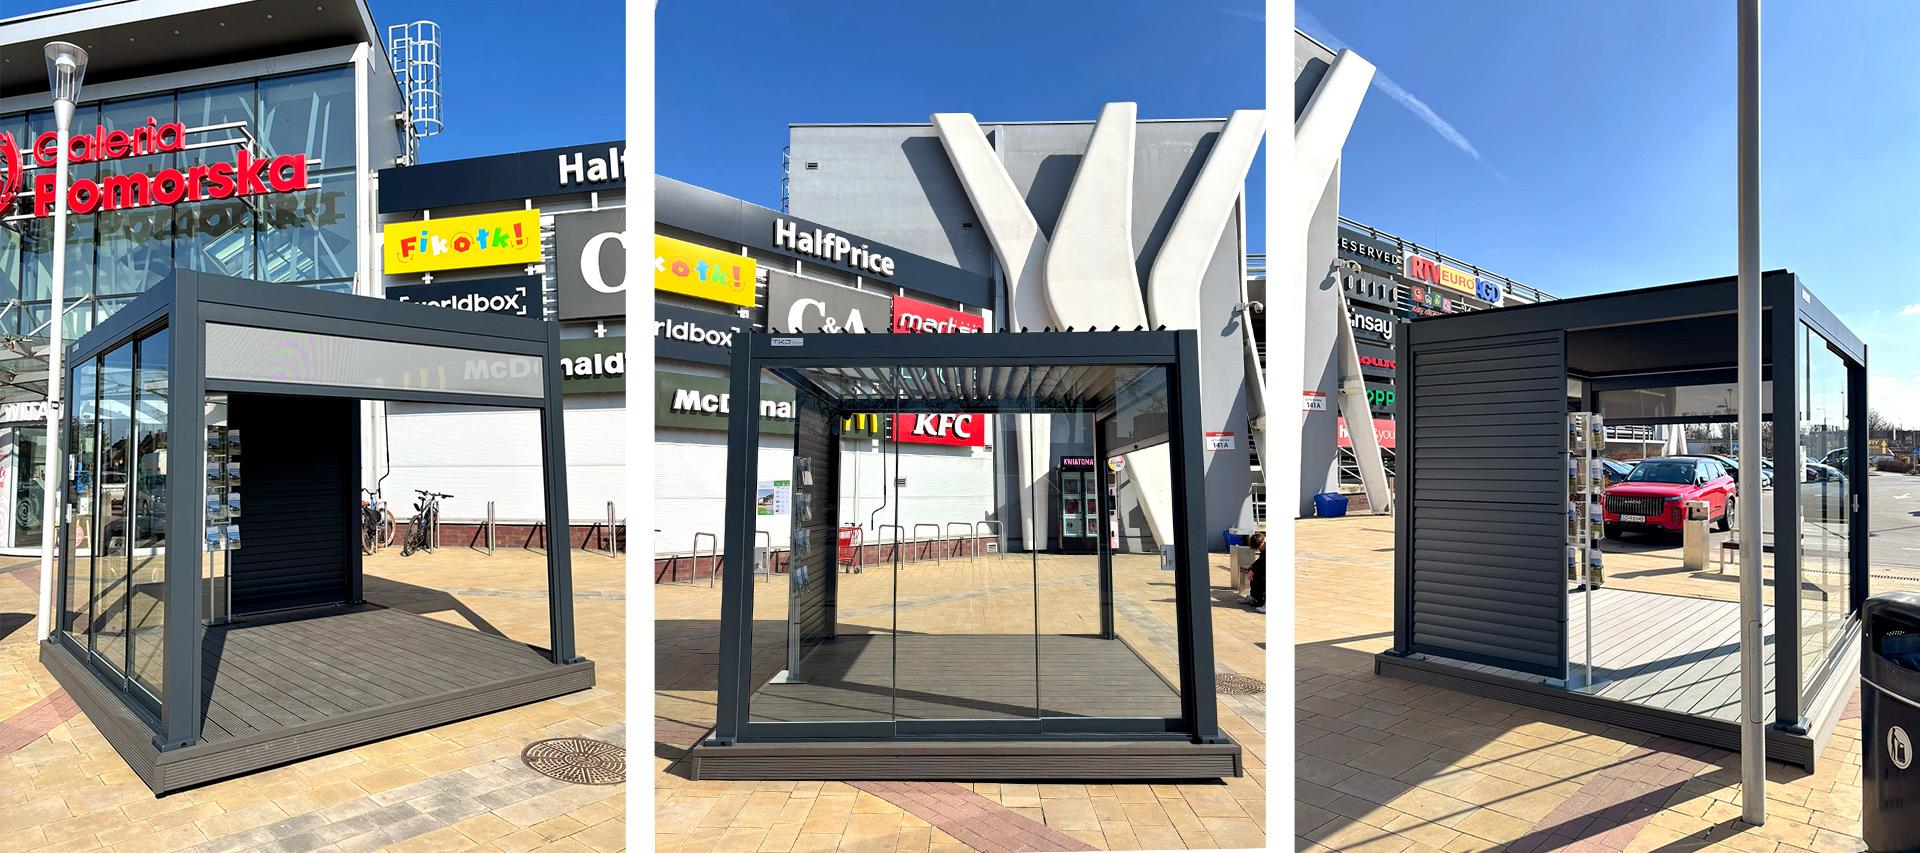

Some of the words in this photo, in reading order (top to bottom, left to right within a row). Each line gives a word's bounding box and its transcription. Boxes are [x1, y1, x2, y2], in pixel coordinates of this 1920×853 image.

[34, 117, 186, 167] Galeria
[34, 150, 309, 217] Pomorska
[773, 218, 894, 277] HalfPrice
[1339, 237, 1398, 265] ESERVED
[1348, 274, 1398, 301] OHITO
[1410, 255, 1440, 285] RTV
[1442, 270, 1475, 290] EURO
[1475, 277, 1500, 303] AGD
[913, 413, 972, 439] KFC
